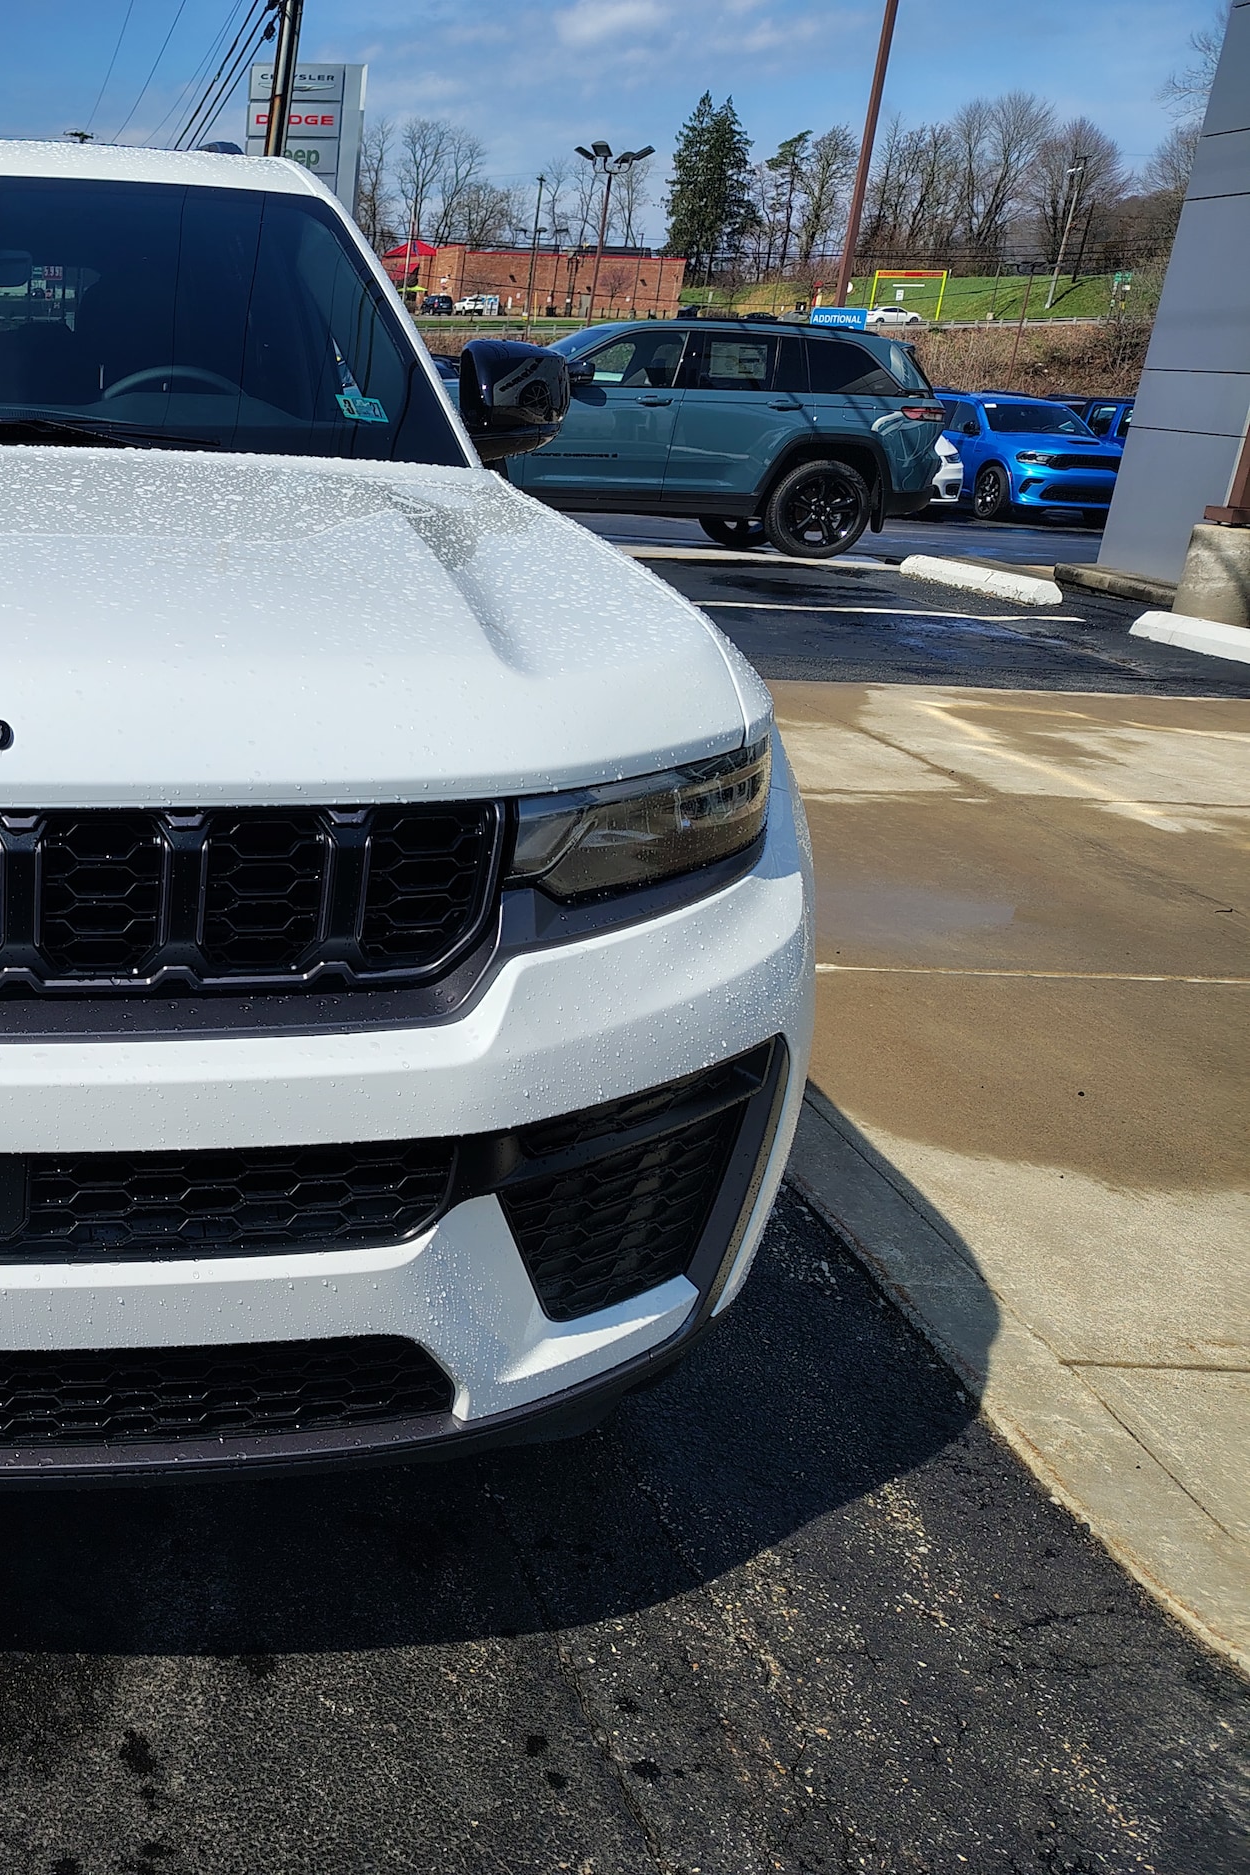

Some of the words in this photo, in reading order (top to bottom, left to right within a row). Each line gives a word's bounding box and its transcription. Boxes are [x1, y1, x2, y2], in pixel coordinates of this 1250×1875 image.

[260, 73, 335, 81] CSLER
[255, 114, 334, 126] DDGE
[284, 148, 320, 169] eep
[813, 314, 862, 324] ADDITIONAL
